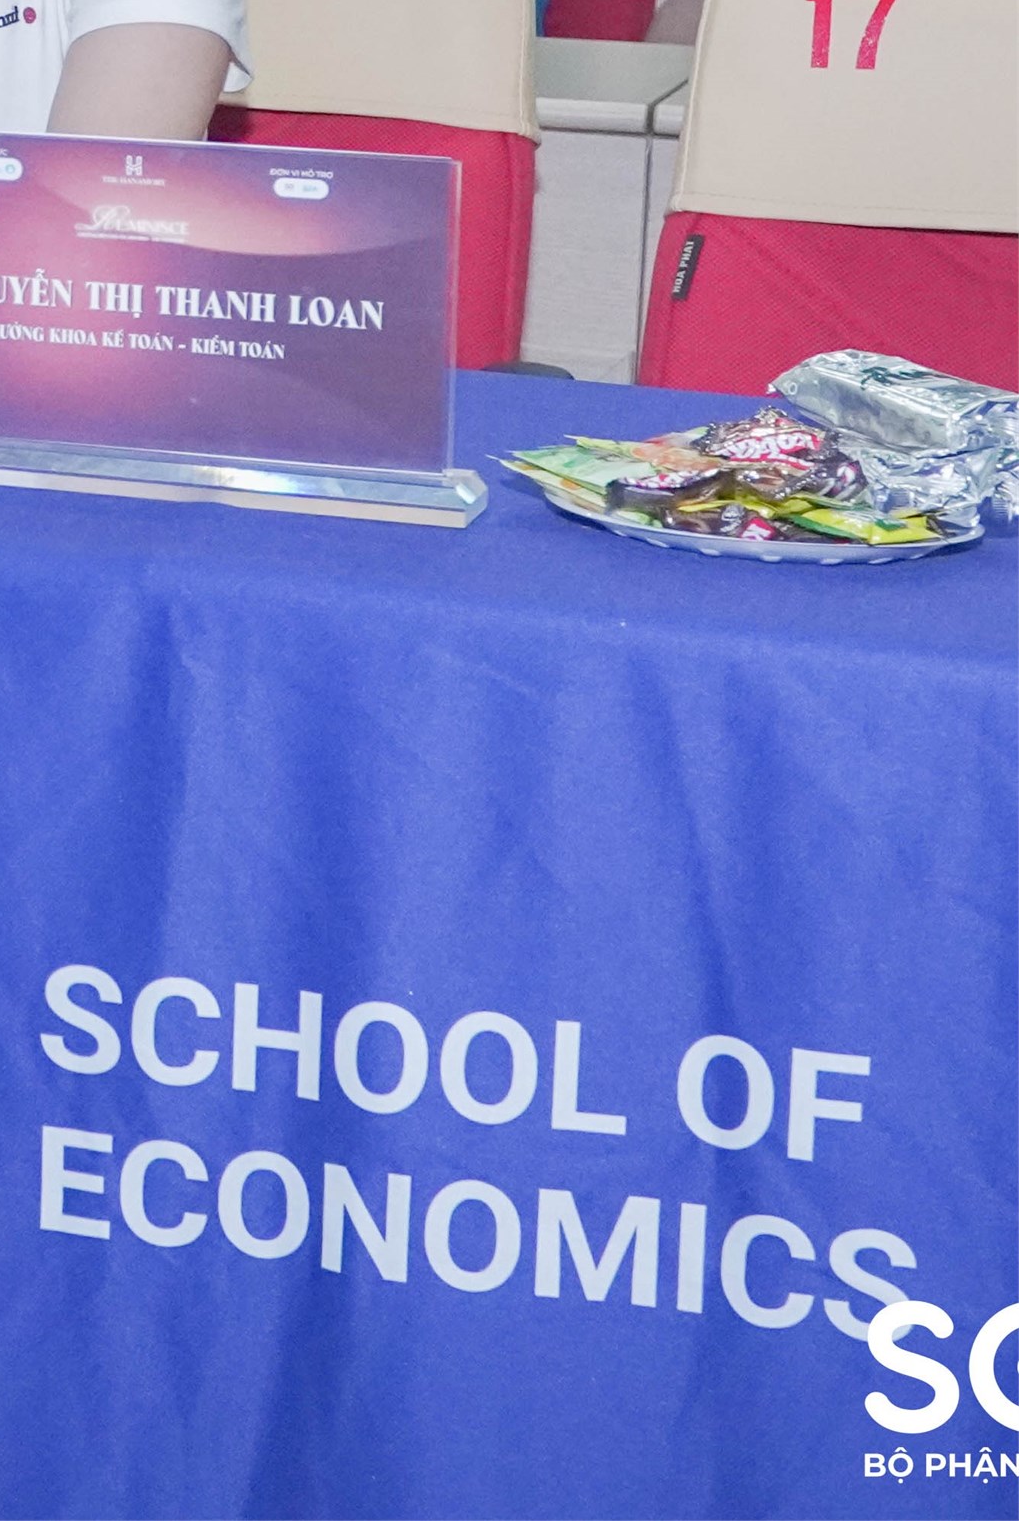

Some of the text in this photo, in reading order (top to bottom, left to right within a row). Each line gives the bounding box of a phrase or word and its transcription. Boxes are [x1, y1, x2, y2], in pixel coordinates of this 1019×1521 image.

[49, 328, 98, 347] KHOA
[101, 329, 125, 348] KẾ
[129, 332, 174, 352] TOÁN
[190, 335, 235, 357] KIỂM
[239, 340, 286, 360] TOÁN
[85, 281, 144, 319] THỊ
[155, 285, 277, 323] THANH
[288, 295, 385, 331] LOAN
[40, 964, 872, 1162] SCHOOL OF
[38, 1125, 918, 1343] ECONOMICS
